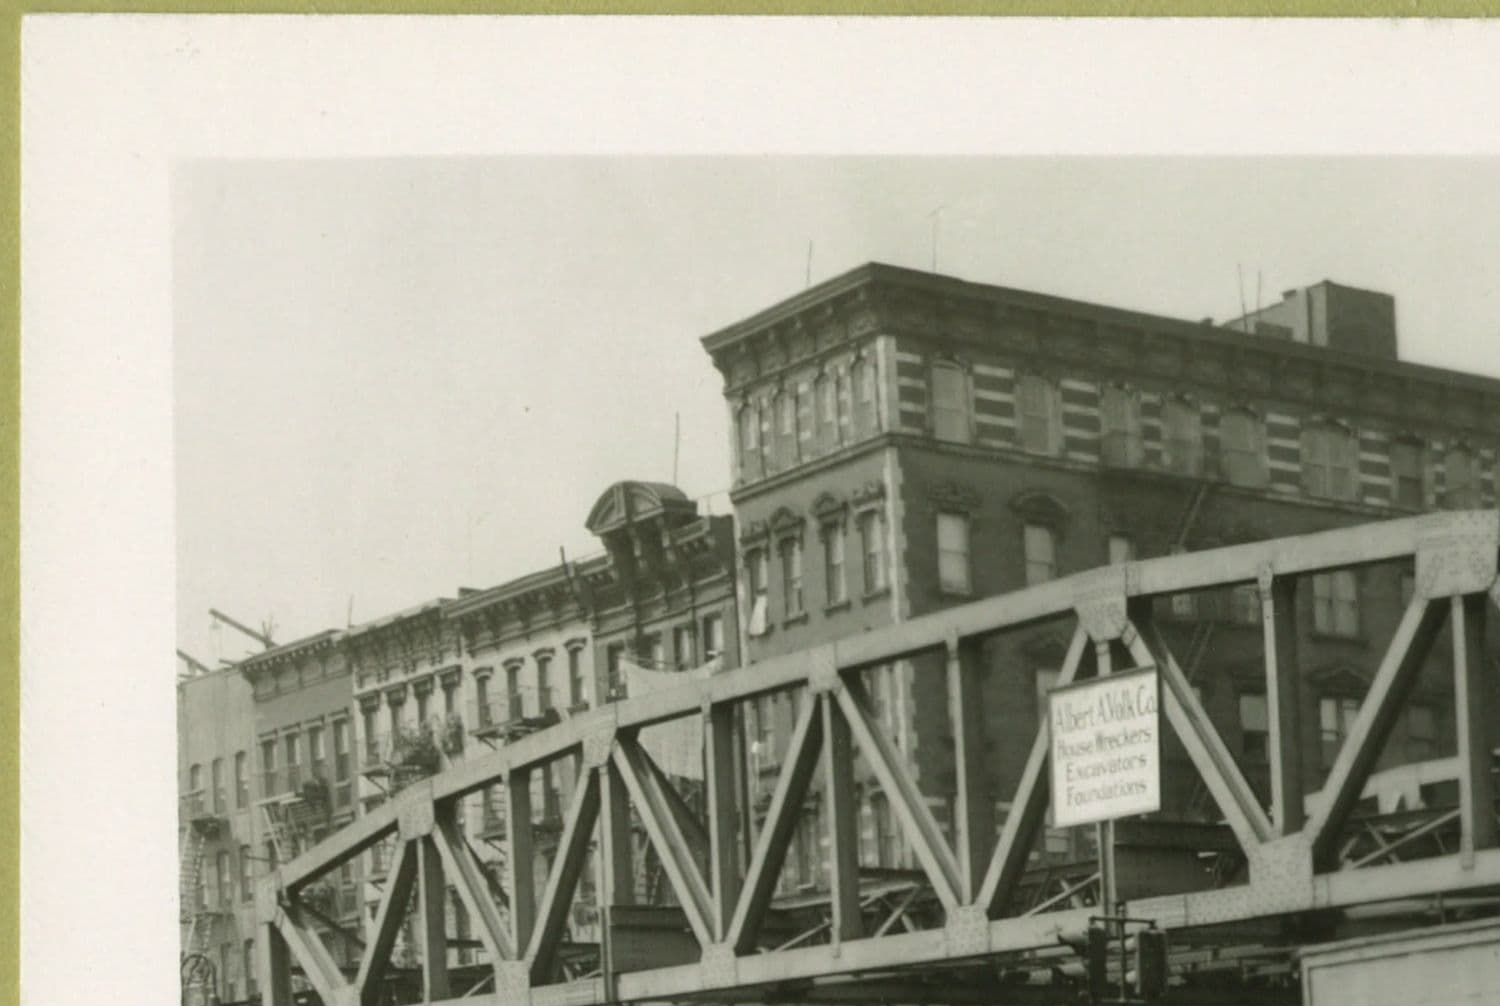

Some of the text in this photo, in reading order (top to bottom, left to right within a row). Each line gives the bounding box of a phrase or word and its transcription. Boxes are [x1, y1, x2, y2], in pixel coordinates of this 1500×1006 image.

[1056, 703, 1095, 732] Albert
[1056, 727, 1152, 760] House Wreckers
[1066, 754, 1147, 783] Excavators
[1066, 779, 1147, 807] Foundations
